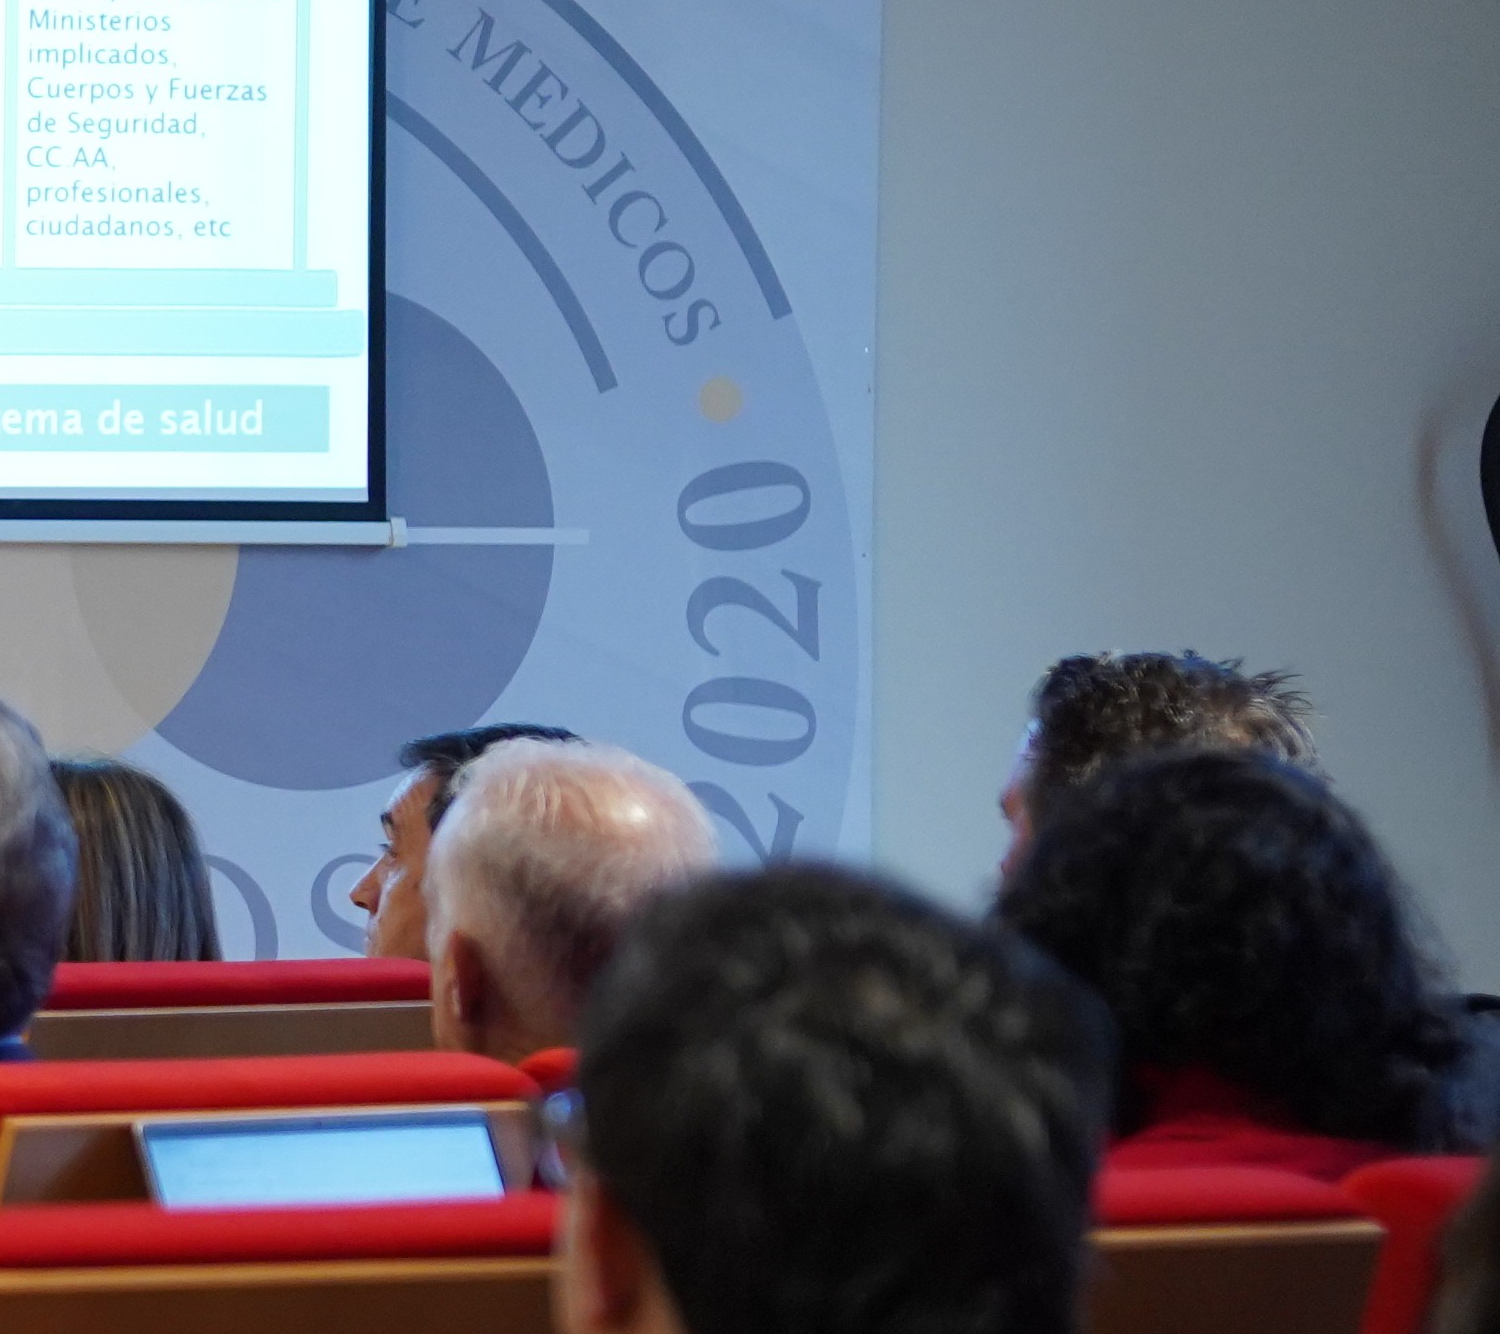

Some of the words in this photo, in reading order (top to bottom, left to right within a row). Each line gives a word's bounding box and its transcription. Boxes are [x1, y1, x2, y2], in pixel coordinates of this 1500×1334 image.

[27, 8, 173, 32] Ministerios
[26, 76, 136, 105] Cuerpos
[144, 82, 159, 105] y
[167, 77, 269, 102] Fuerzas
[26, 111, 57, 134] de
[67, 111, 207, 140] Seguridad,
[446, 7, 723, 347] MEDICOS
[25, 180, 210, 208] profesionales,
[25, 214, 184, 241] ciudadanos,
[96, 398, 145, 437] de
[158, 398, 264, 438] salud
